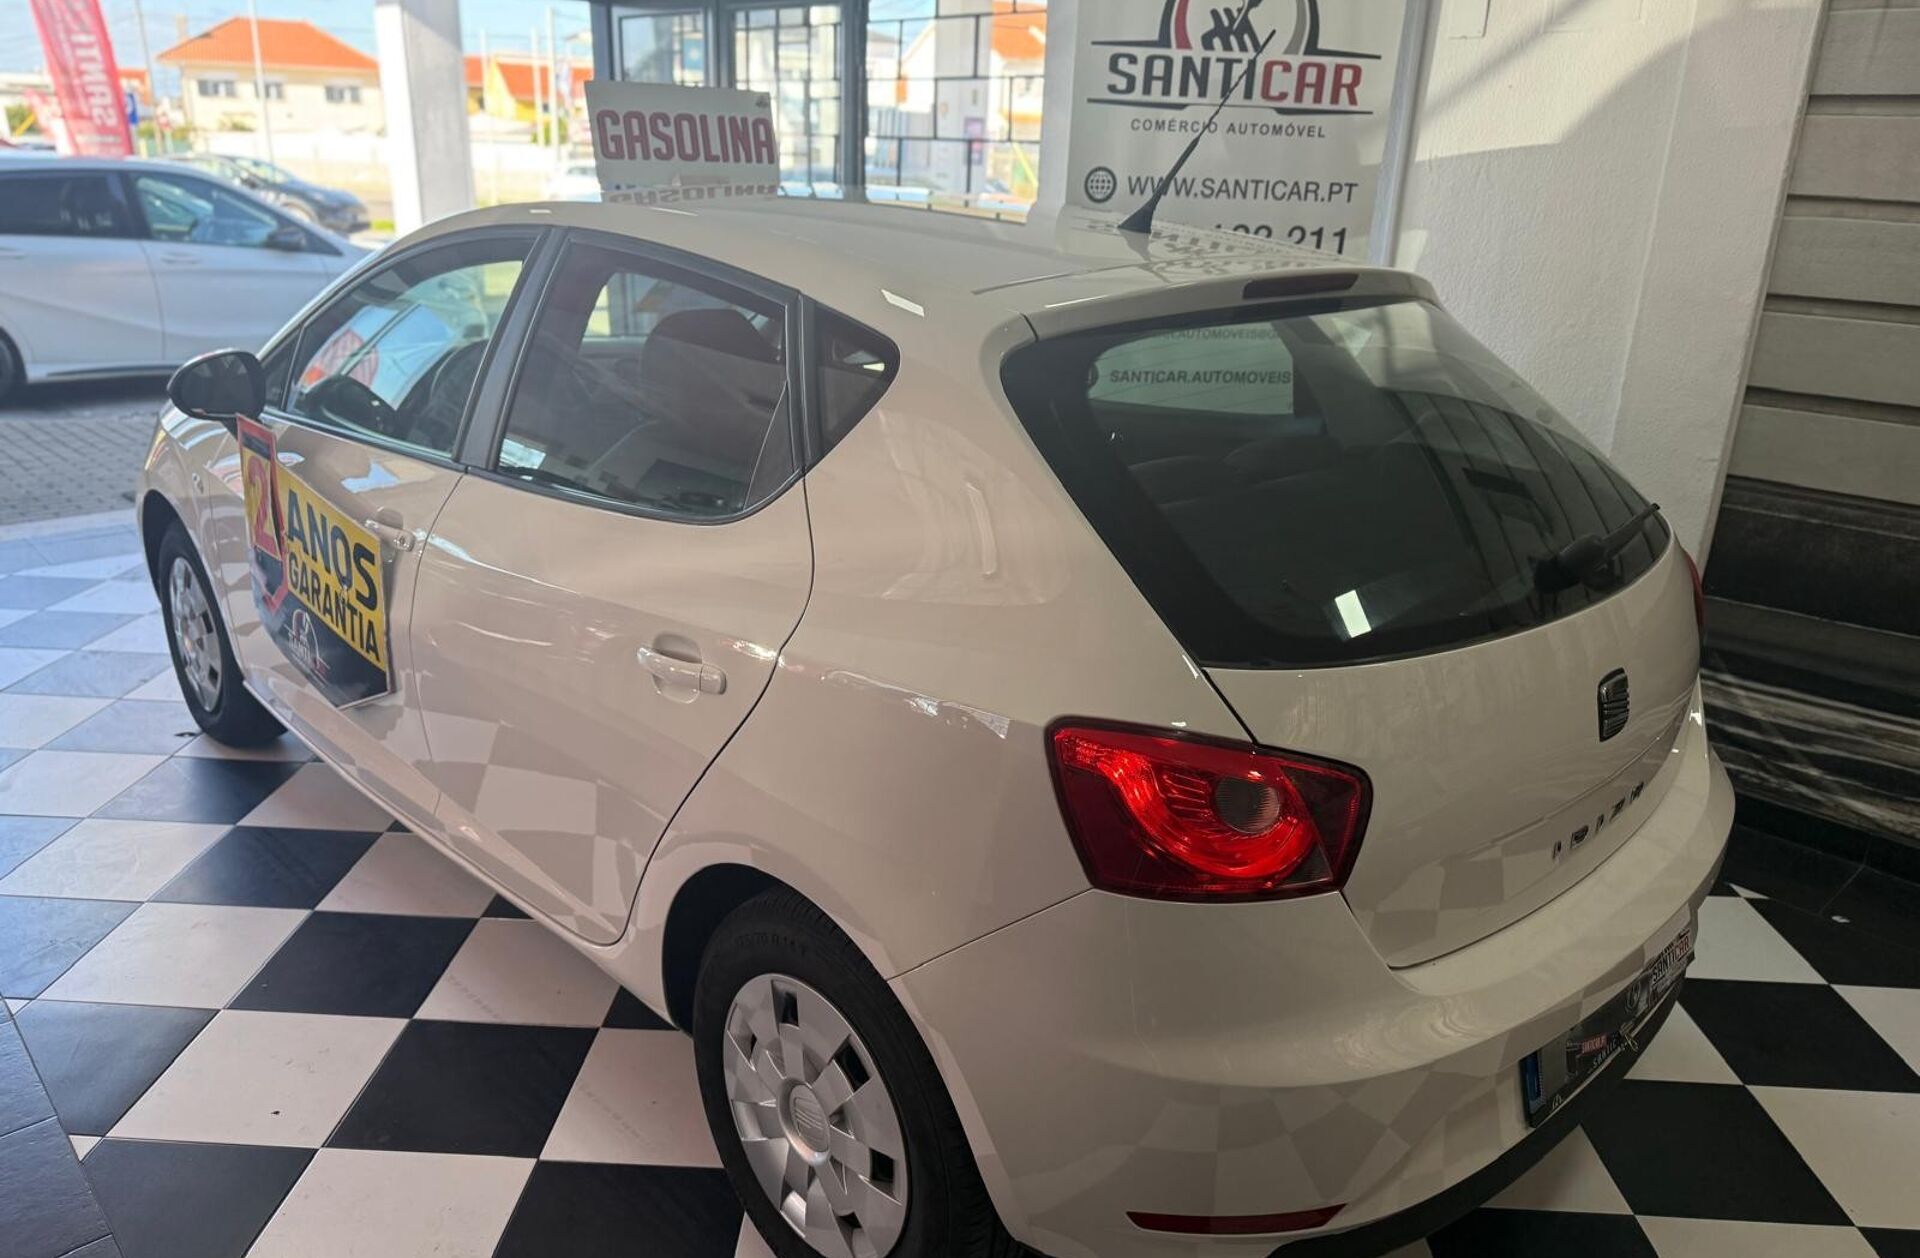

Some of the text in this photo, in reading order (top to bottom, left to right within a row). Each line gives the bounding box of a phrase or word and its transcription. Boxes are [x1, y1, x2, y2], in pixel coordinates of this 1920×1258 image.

[1107, 52, 1363, 107] SANTICAR
[596, 109, 775, 165] GASOLINA
[1130, 117, 1326, 139] COMÉRCIO AUTOMÓVEL
[1127, 175, 1359, 205] WWW.SANTICAR.PT
[1109, 370, 1291, 385] SANTICAR.AUTOMOVEIS
[246, 454, 377, 613] 2 ANOS
[288, 550, 380, 662] GARANTIA
